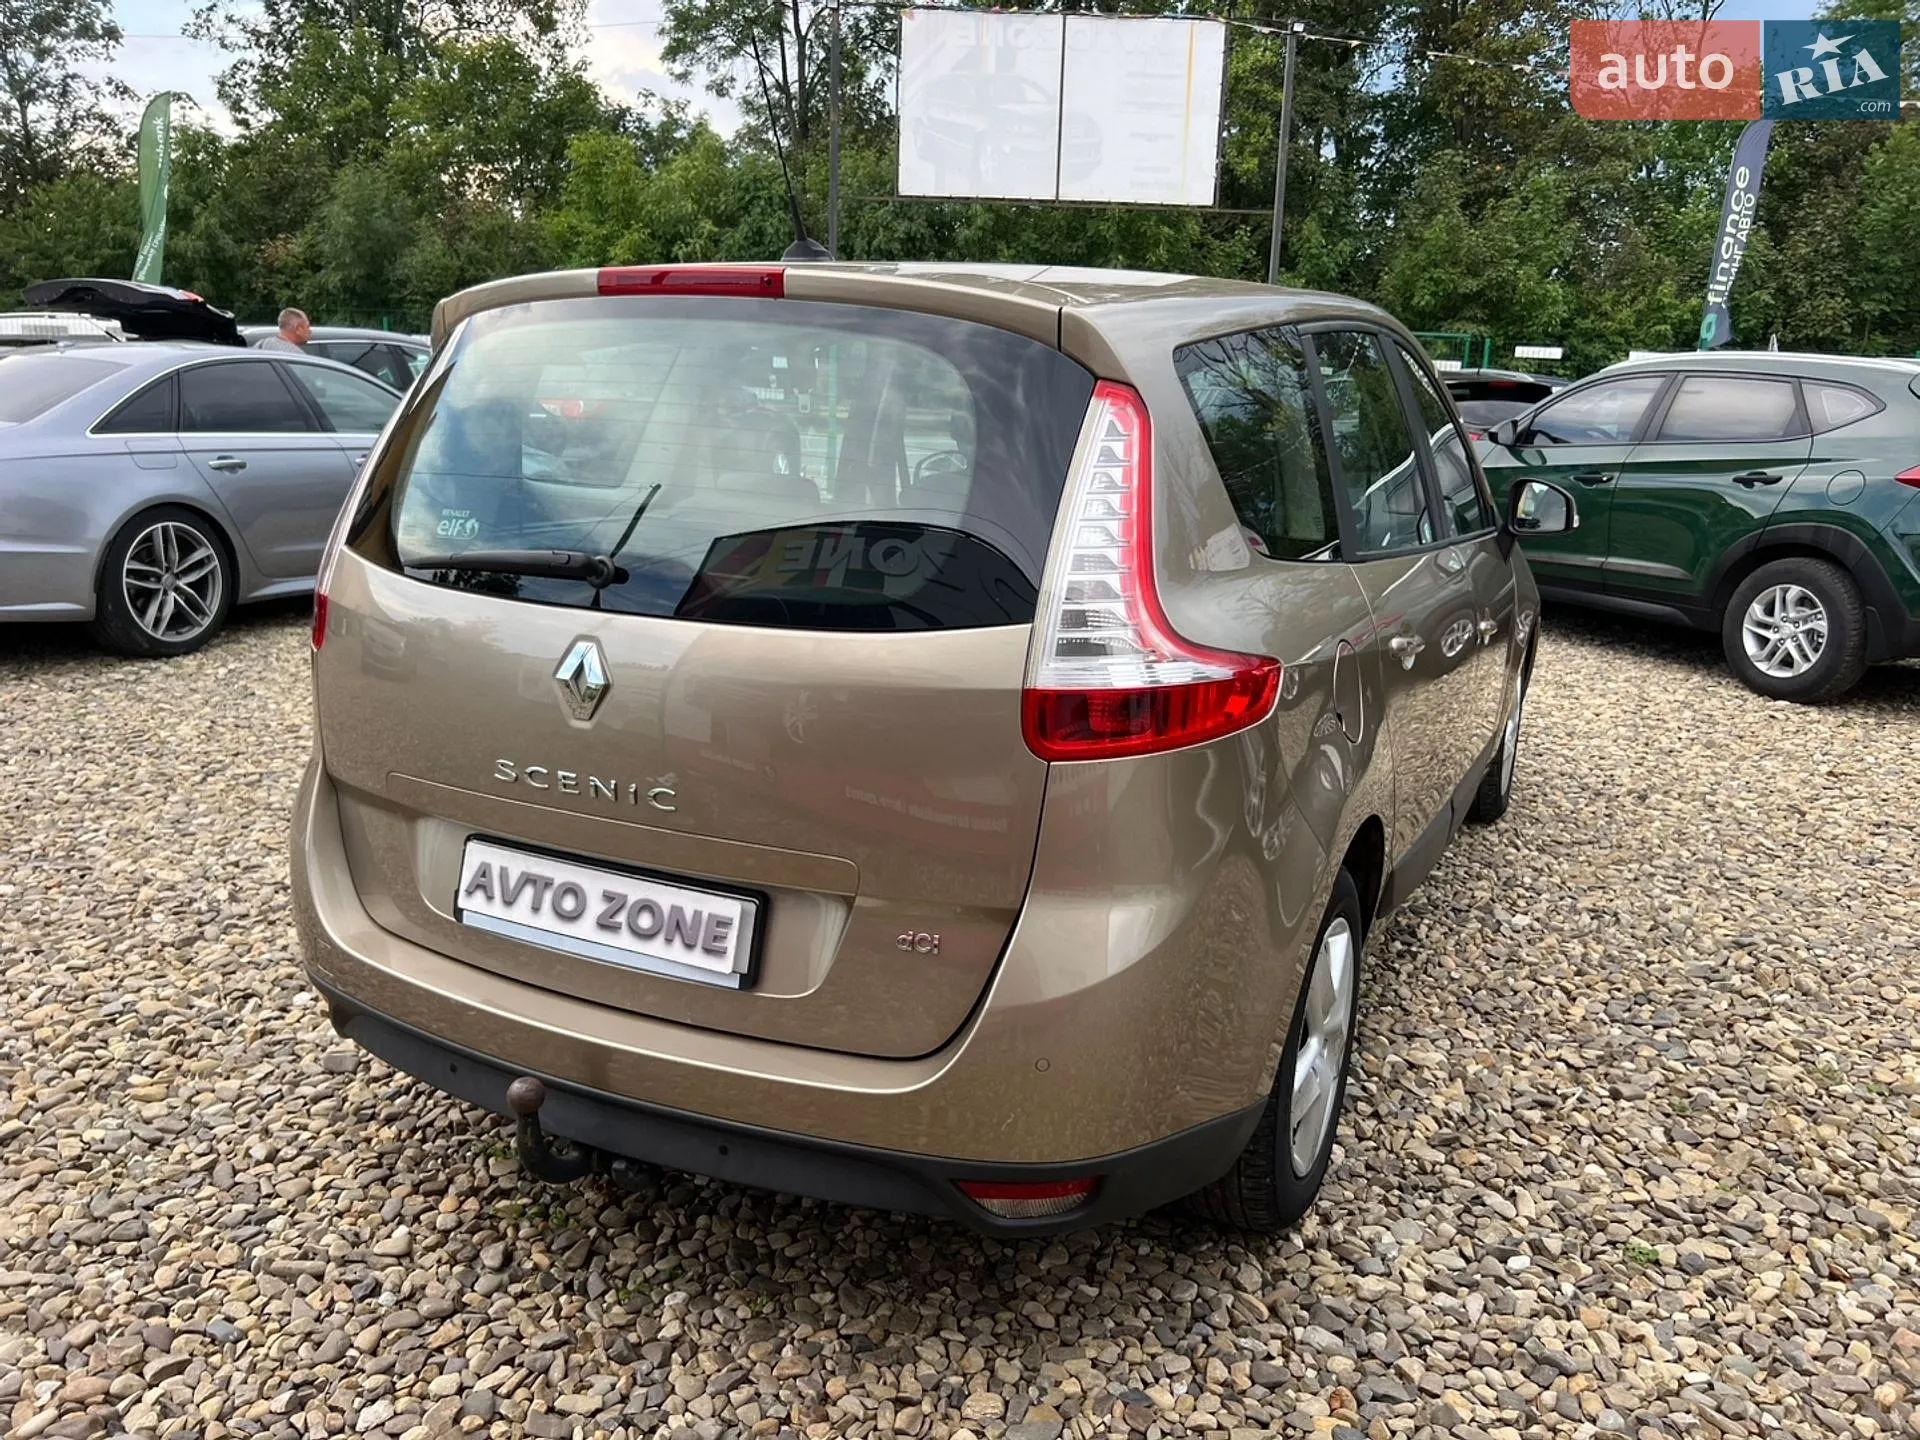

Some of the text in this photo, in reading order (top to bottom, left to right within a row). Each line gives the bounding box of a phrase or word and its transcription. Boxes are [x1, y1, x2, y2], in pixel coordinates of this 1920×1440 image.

[1706, 165, 1750, 307] finance
[1735, 193, 1756, 243] АВТО
[493, 758, 678, 813] SCENIC
[464, 860, 735, 955] AVTO ZONE
